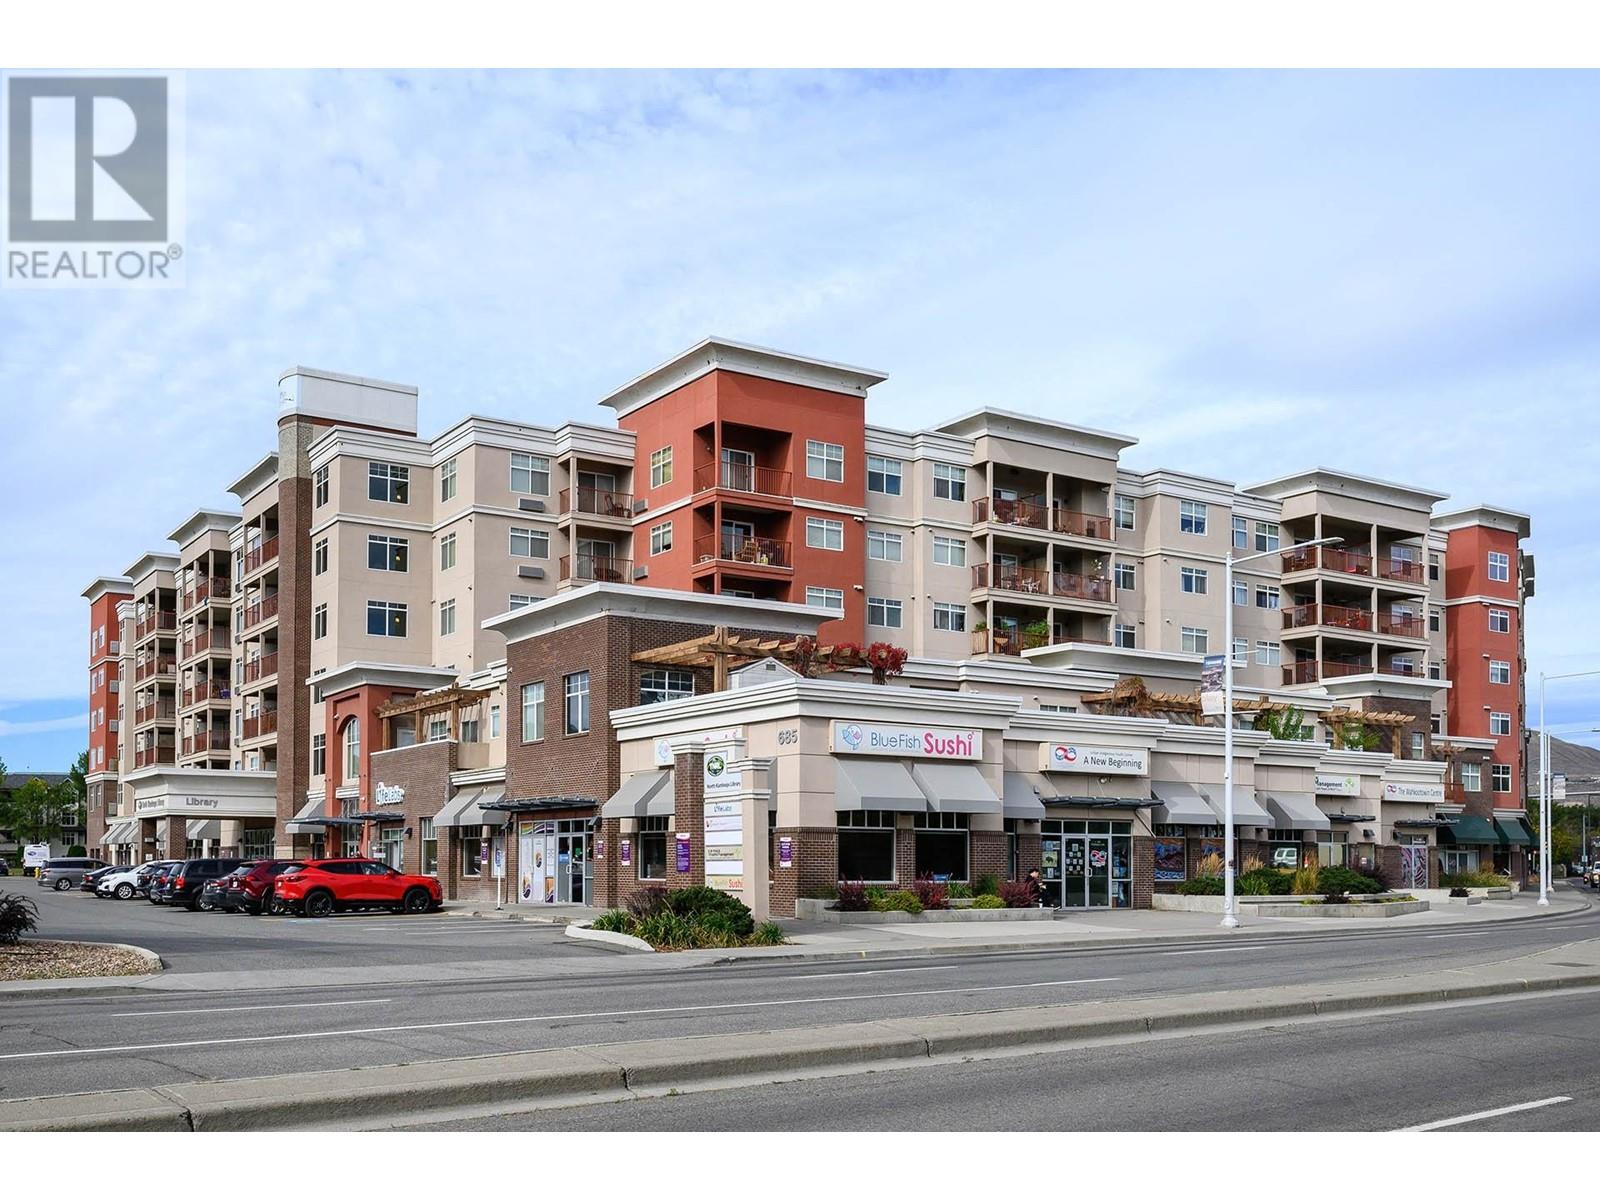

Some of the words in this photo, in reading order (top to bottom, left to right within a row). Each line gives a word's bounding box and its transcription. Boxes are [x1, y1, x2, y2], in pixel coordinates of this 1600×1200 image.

[778, 729, 798, 746] 685
[870, 731, 921, 748] BlueFish
[923, 732, 974, 756] Sushi
[1083, 756, 1090, 765] A
[1090, 756, 1106, 766] New
[1108, 757, 1142, 770] Beginning
[186, 797, 219, 809] Library
